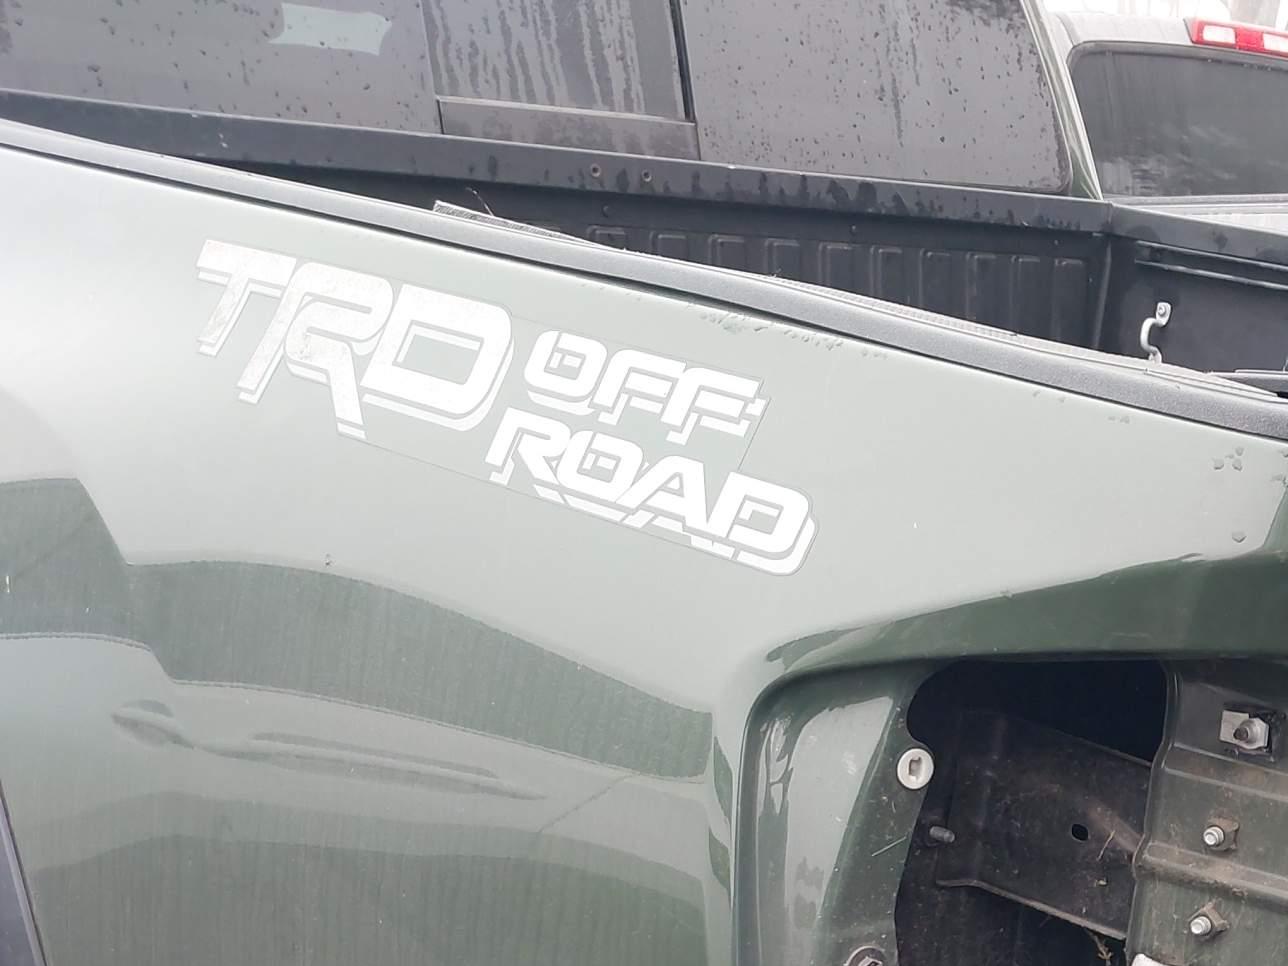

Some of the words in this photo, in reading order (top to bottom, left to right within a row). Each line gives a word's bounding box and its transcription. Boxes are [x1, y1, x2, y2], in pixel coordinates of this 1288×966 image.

[197, 239, 513, 438] TRD
[523, 330, 771, 445] OFF
[484, 407, 819, 577] ROAD
